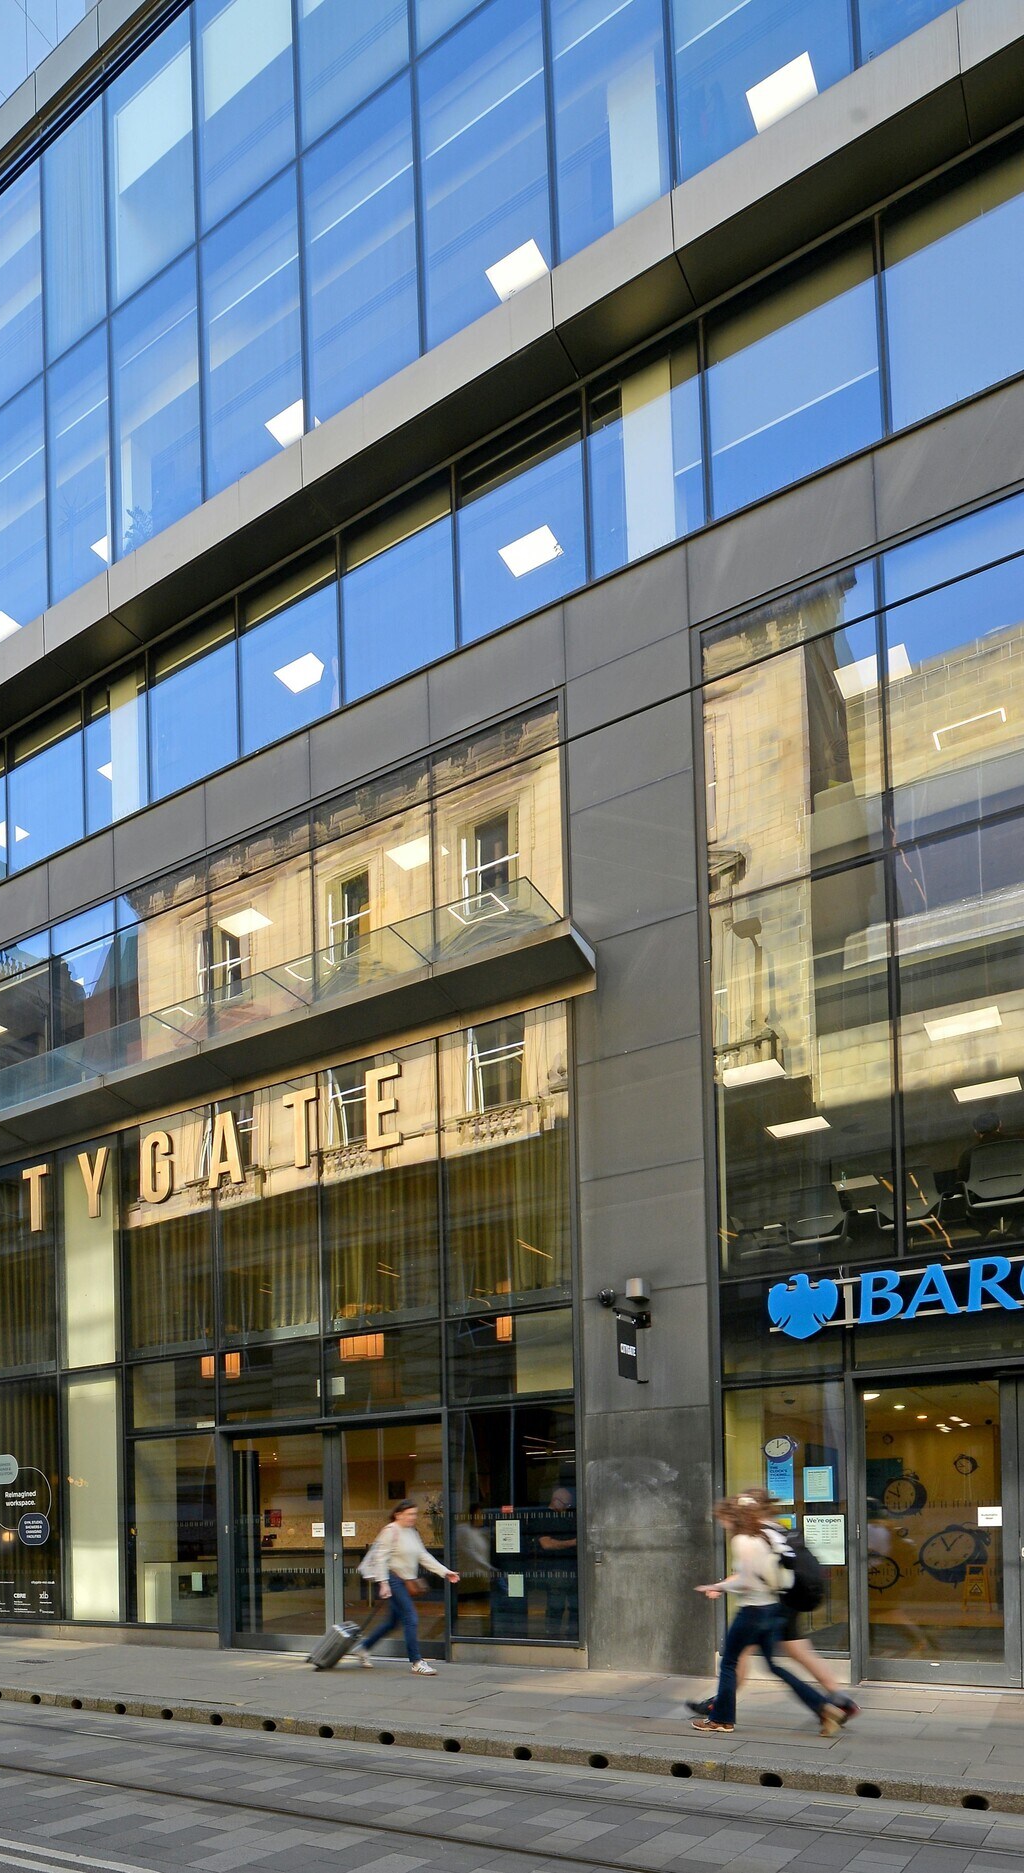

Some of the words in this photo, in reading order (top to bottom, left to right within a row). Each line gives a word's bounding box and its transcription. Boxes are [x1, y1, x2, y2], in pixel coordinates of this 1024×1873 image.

[858, 1256, 1024, 1324] BAR
[620, 1342, 636, 1357] CITYGATE
[4, 1490, 37, 1499] Reimagined
[5, 1500, 36, 1508] workspace.
